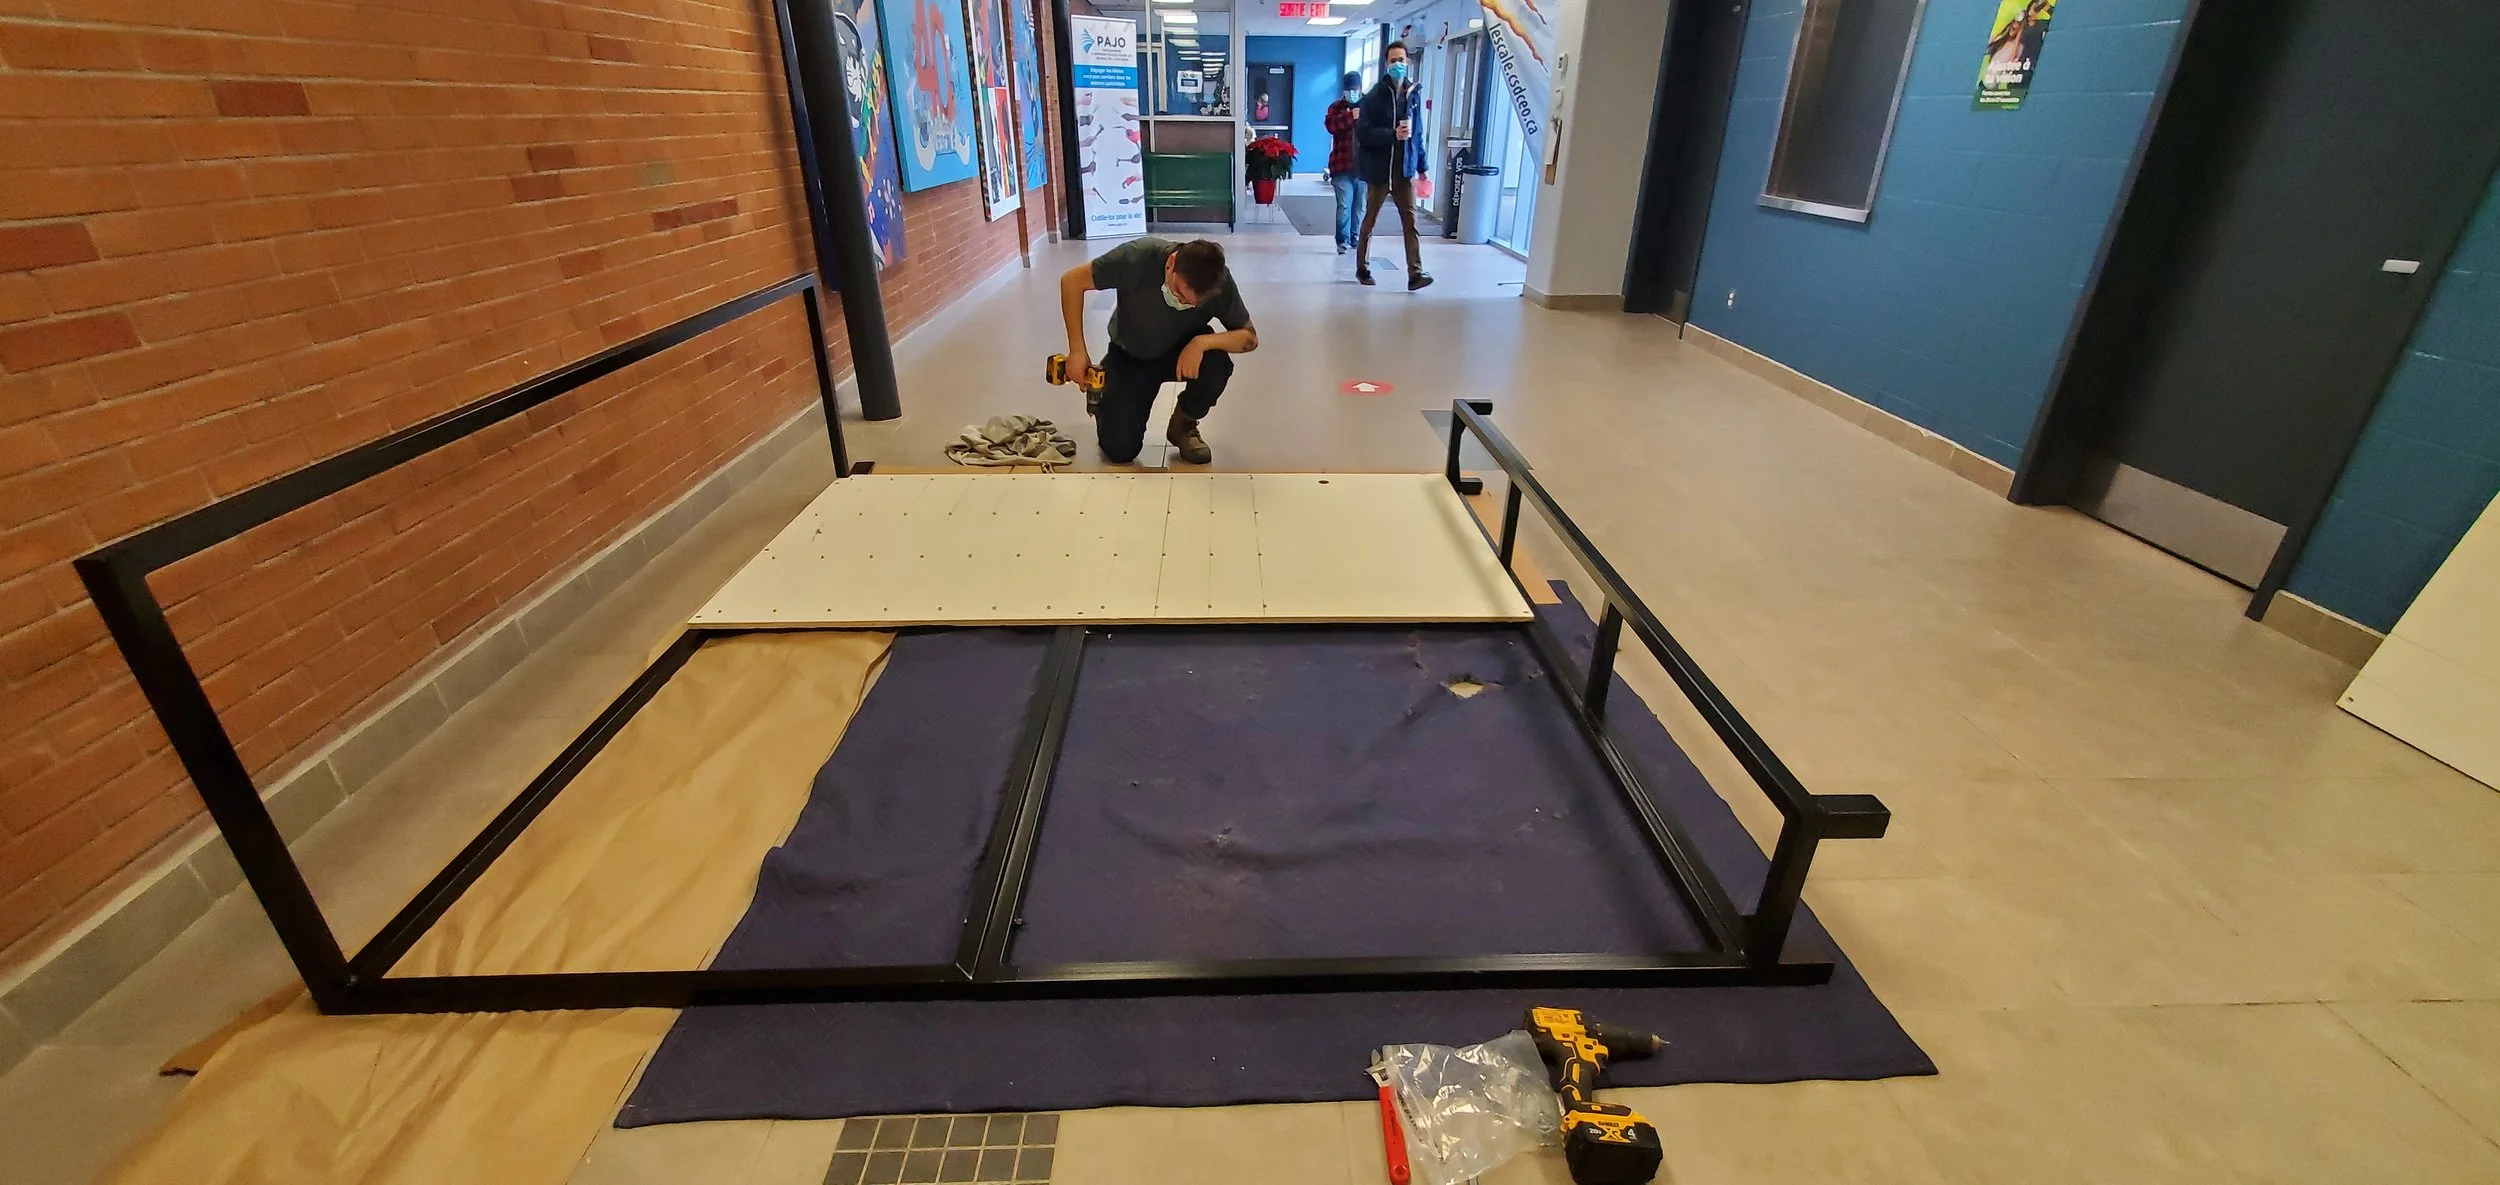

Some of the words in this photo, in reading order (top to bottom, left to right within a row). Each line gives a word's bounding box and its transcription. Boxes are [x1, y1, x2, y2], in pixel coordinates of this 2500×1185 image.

[1279, 2, 1306, 17] SORTIE
[1310, 3, 1329, 17] EXIT
[1097, 36, 1126, 48] PAJO
[1488, 22, 1538, 135] lescale.csdceo.ca
[1455, 157, 1463, 172] VOS
[1452, 174, 1462, 206] DÉPOSEZ
